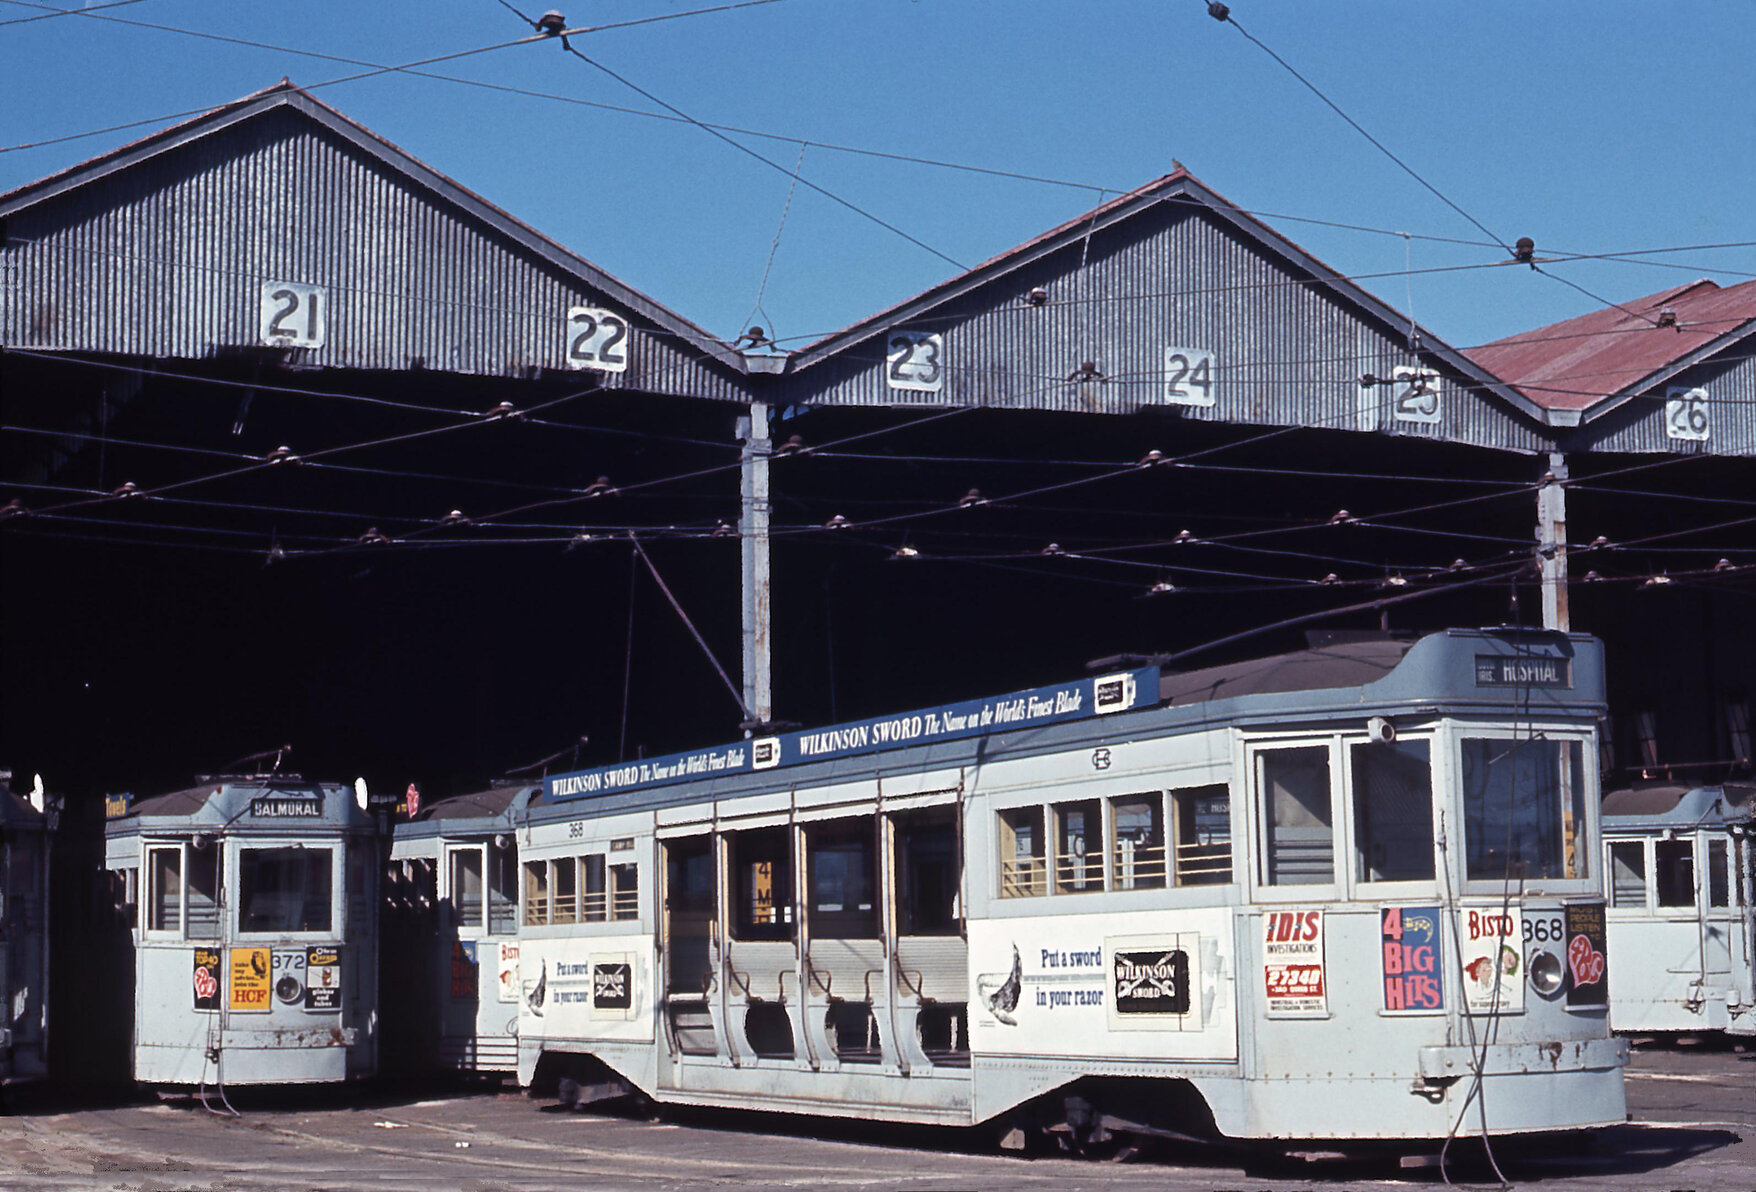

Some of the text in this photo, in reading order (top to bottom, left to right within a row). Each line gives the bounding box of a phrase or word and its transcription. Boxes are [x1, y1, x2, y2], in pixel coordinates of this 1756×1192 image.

[269, 289, 317, 340] 21
[571, 314, 626, 364] 22
[890, 337, 940, 383] 23
[1168, 354, 1213, 397] 24
[1671, 392, 1707, 434] 26
[1503, 660, 1559, 682] HOSPITAL
[800, 726, 869, 755] WILKINSON
[872, 716, 922, 744] SWORD
[924, 713, 940, 735] The
[941, 711, 967, 733] Name
[968, 713, 979, 728] on
[980, 705, 994, 727] the
[1026, 696, 1054, 719] Finest
[1055, 688, 1082, 714] Blade
[552, 773, 602, 796] WILKINSON
[604, 766, 638, 789] SWORD
[639, 765, 651, 783] The
[651, 763, 669, 780] Name
[677, 758, 686, 776] the
[726, 748, 745, 768] Blade
[255, 801, 319, 816] BALMORAL
[569, 822, 583, 838] 368
[1266, 911, 1320, 943] IDIS
[1383, 907, 1403, 940] 4
[1468, 910, 1514, 941] BISTO
[1521, 918, 1563, 942] 368
[1569, 923, 1600, 932] LISTEN
[1041, 946, 1102, 968] Put a sword
[1267, 943, 1317, 954] INVESTIGATIONS
[1384, 941, 1435, 975] BIG
[272, 954, 305, 969] 372
[557, 960, 588, 976] Put a sword
[1116, 965, 1175, 980] WILKINSON
[595, 974, 625, 984] WILKINSON
[1267, 969, 1321, 986] 27340
[234, 989, 267, 1003] HCF
[554, 989, 588, 1005] in your razor
[1036, 986, 1104, 1010] in your razor
[1132, 988, 1160, 998] SWORD
